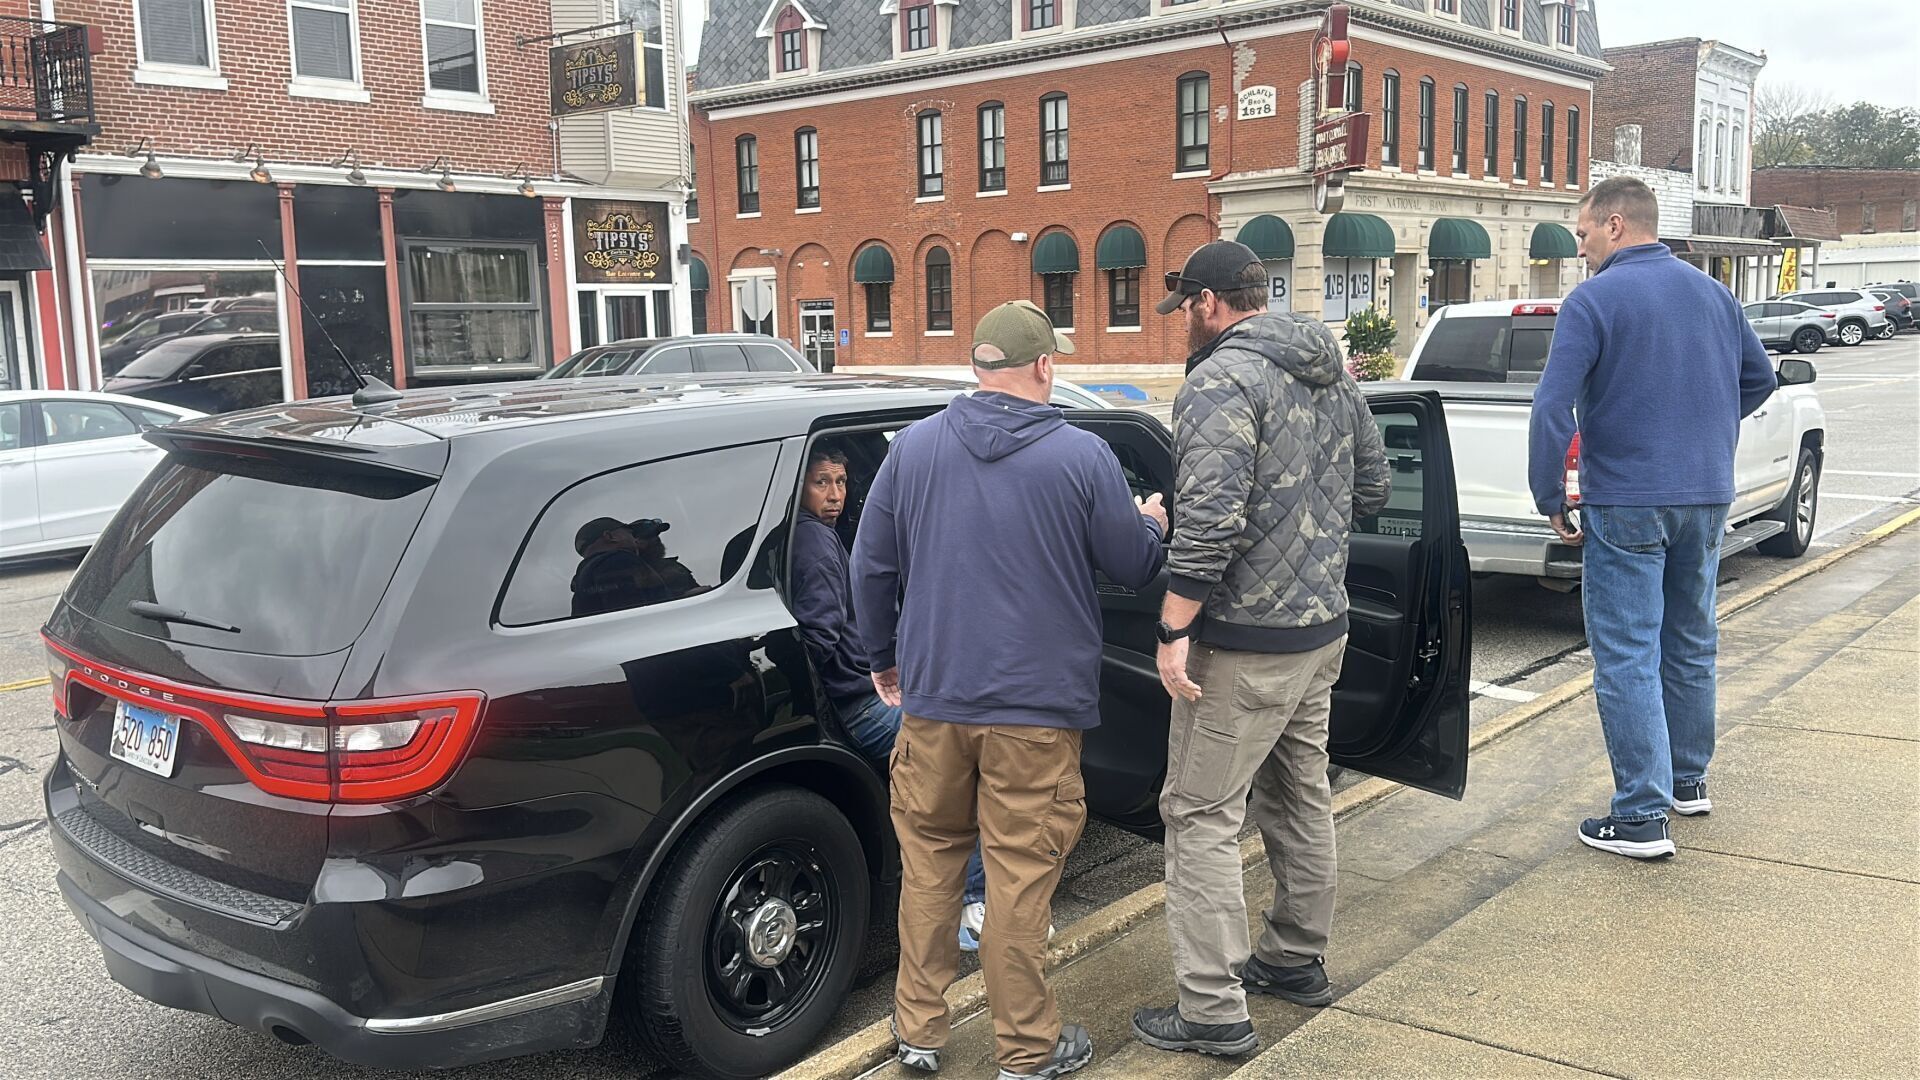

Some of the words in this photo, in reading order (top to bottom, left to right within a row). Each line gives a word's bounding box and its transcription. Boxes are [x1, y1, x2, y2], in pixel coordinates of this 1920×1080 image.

[1240, 89, 1273, 104] SCHLAFLY
[1242, 104, 1271, 116] 1878
[1355, 195, 1378, 207] FIRST
[1386, 197, 1421, 210] NATIONAL
[1429, 199, 1448, 211] BANK
[1781, 251, 1796, 290] PEN
[1325, 274, 1344, 299] 1NB
[1351, 274, 1370, 298] 1NB
[84, 666, 174, 702] DODGE
[120, 715, 144, 751] 520
[147, 725, 173, 762] 850
